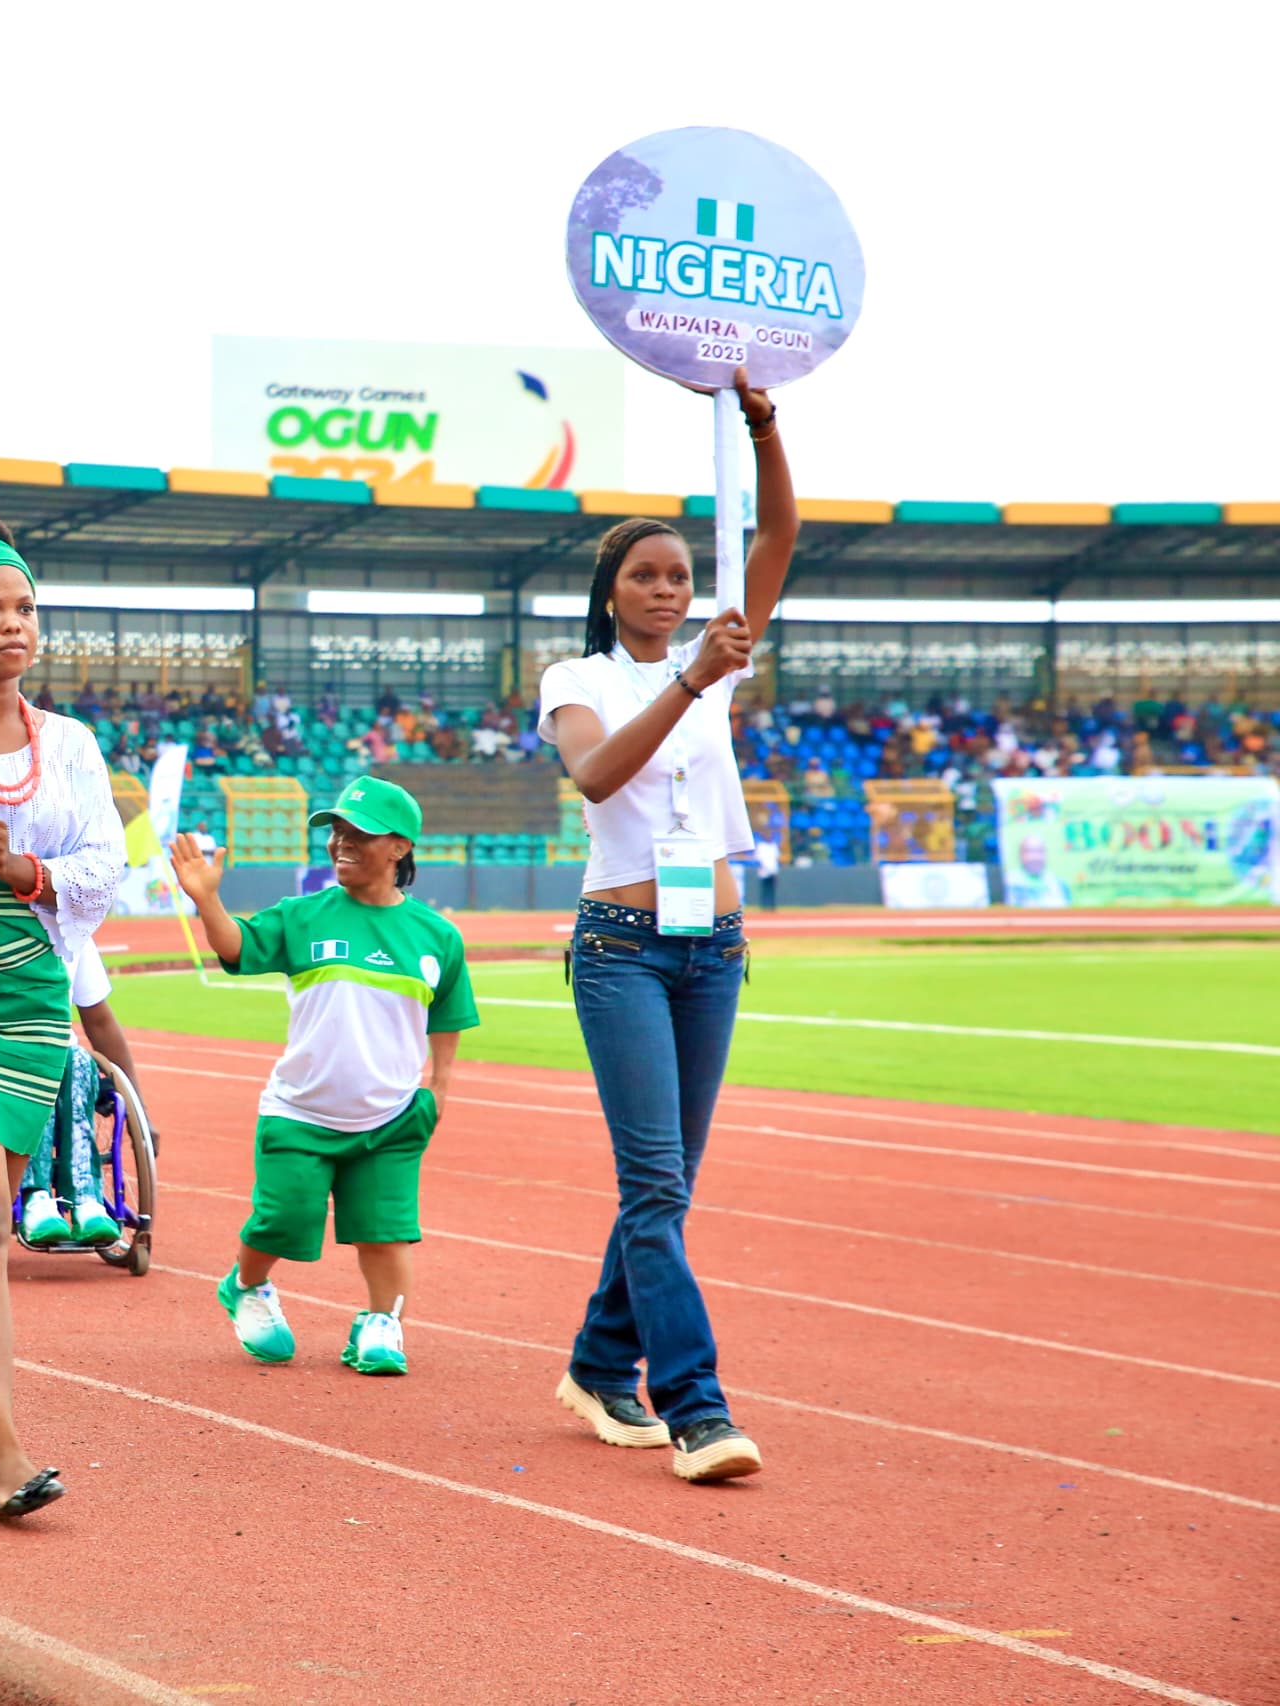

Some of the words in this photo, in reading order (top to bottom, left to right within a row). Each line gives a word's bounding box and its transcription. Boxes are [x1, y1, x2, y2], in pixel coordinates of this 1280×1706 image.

[592, 231, 842, 319] NIGERIA
[640, 311, 739, 339] WAPARA
[756, 328, 810, 349] OGUN
[701, 343, 745, 362] 2025
[265, 382, 352, 404] Gateway
[358, 386, 426, 403] Games
[267, 406, 438, 451] OGUN
